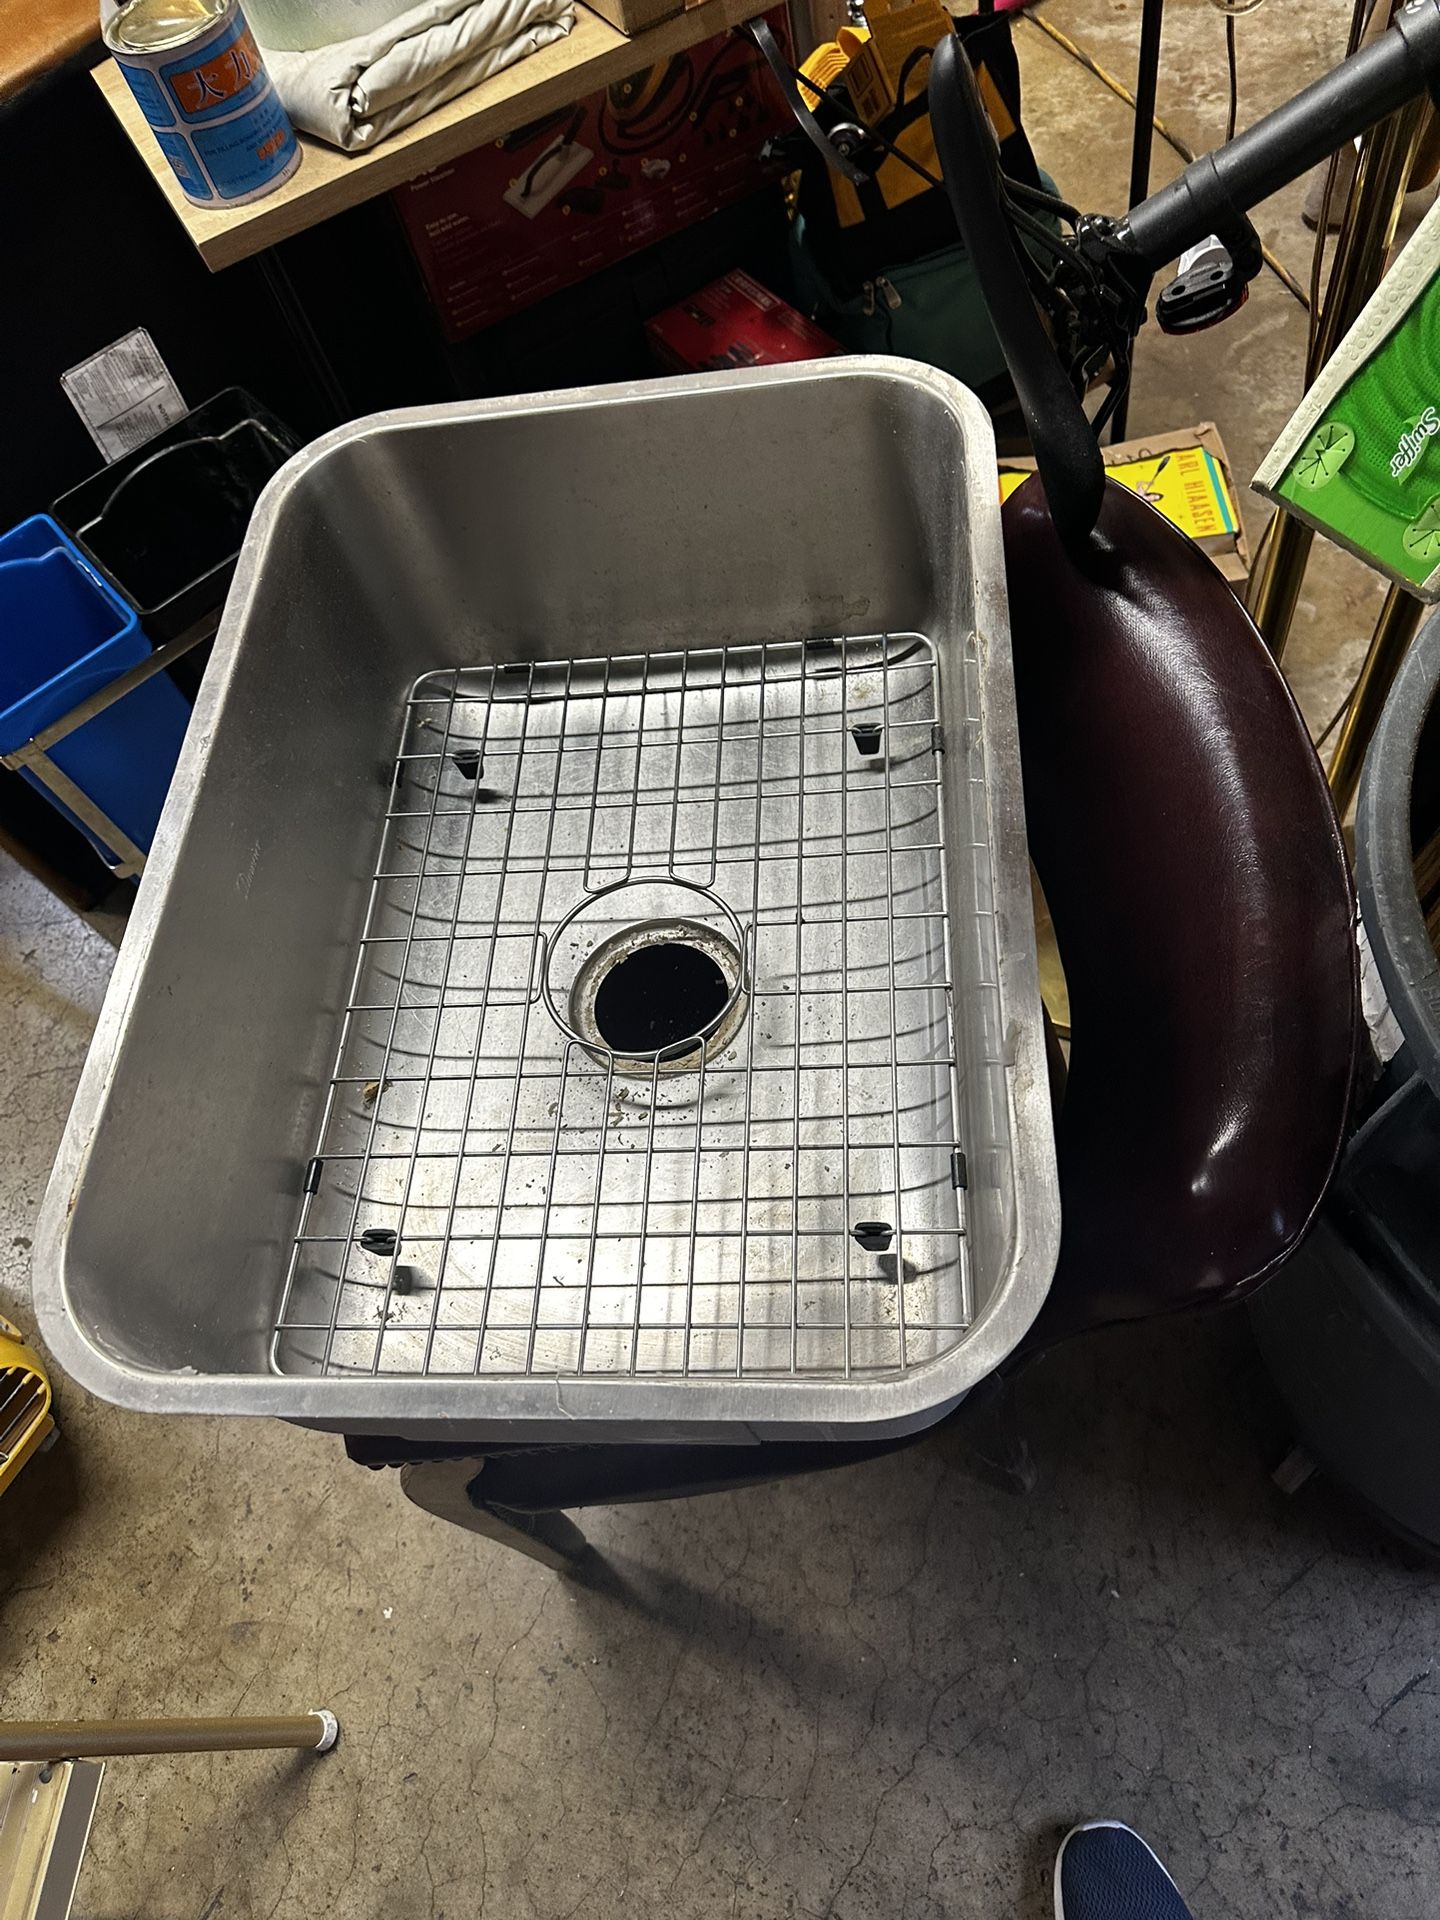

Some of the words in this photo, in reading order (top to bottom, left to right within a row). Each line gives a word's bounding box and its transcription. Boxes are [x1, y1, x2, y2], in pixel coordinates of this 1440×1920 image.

[1176, 453, 1201, 476] ARL
[1390, 406, 1440, 477] Swiffer
[1183, 480, 1217, 533] HIAASEN
